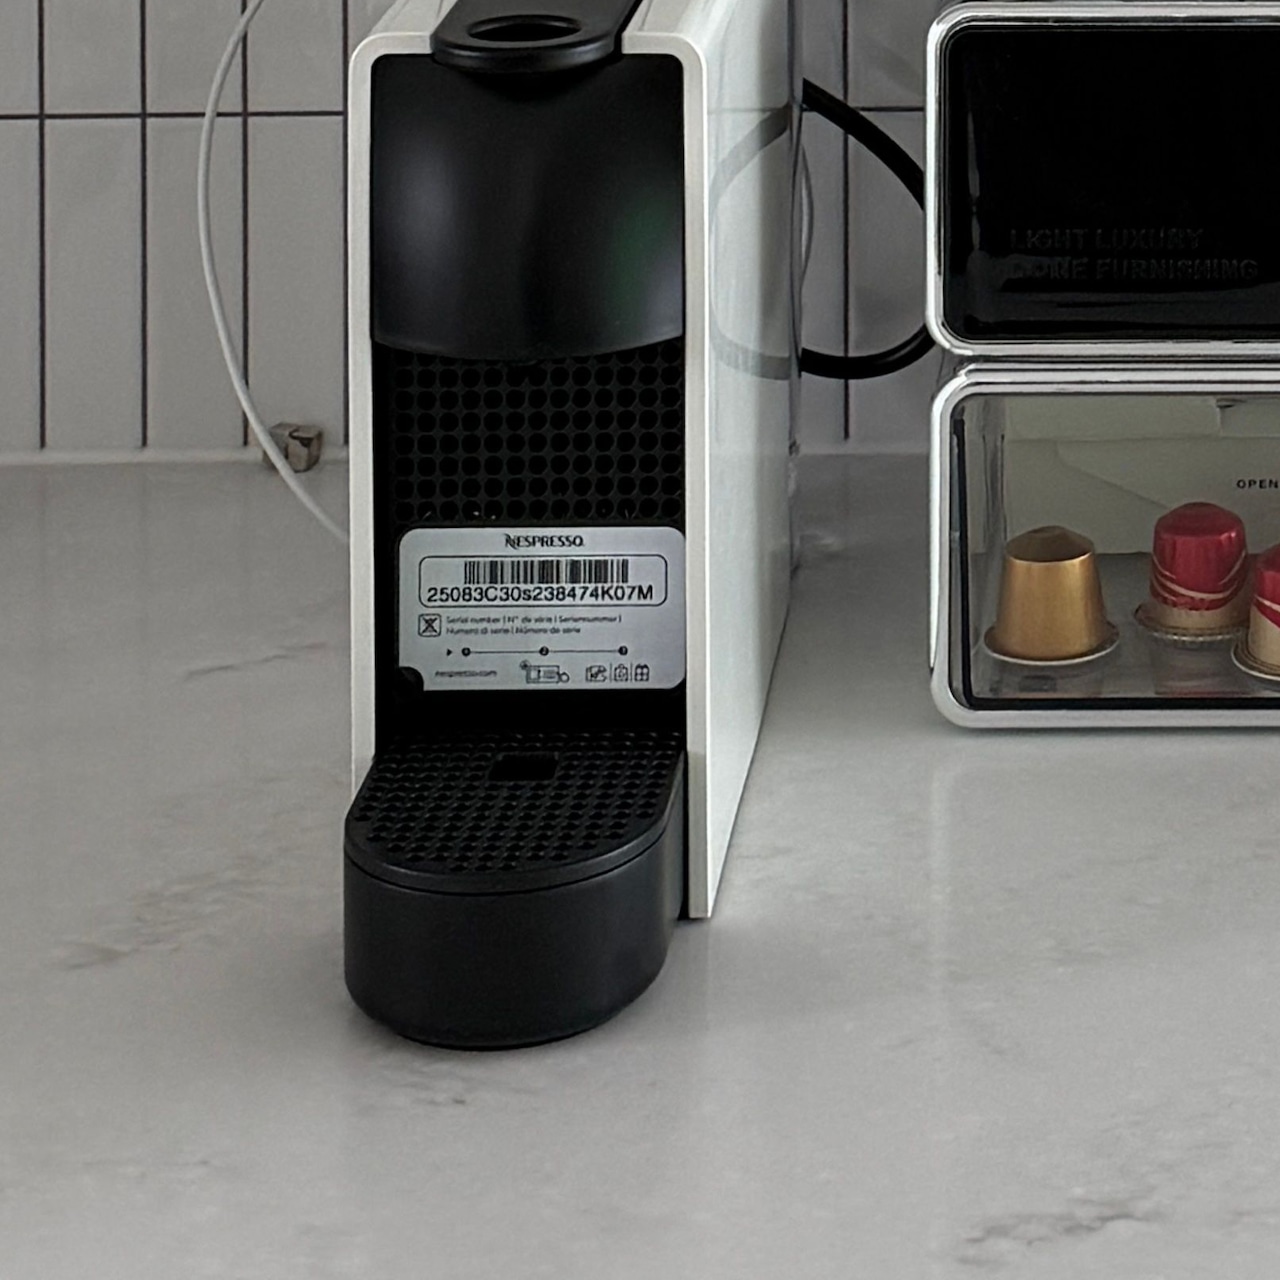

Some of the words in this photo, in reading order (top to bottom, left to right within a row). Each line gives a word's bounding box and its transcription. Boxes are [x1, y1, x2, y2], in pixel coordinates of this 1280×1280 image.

[1010, 228, 1088, 250] LIGHT
[1236, 479, 1279, 489] OPEN
[504, 533, 586, 550] NESPRESSO
